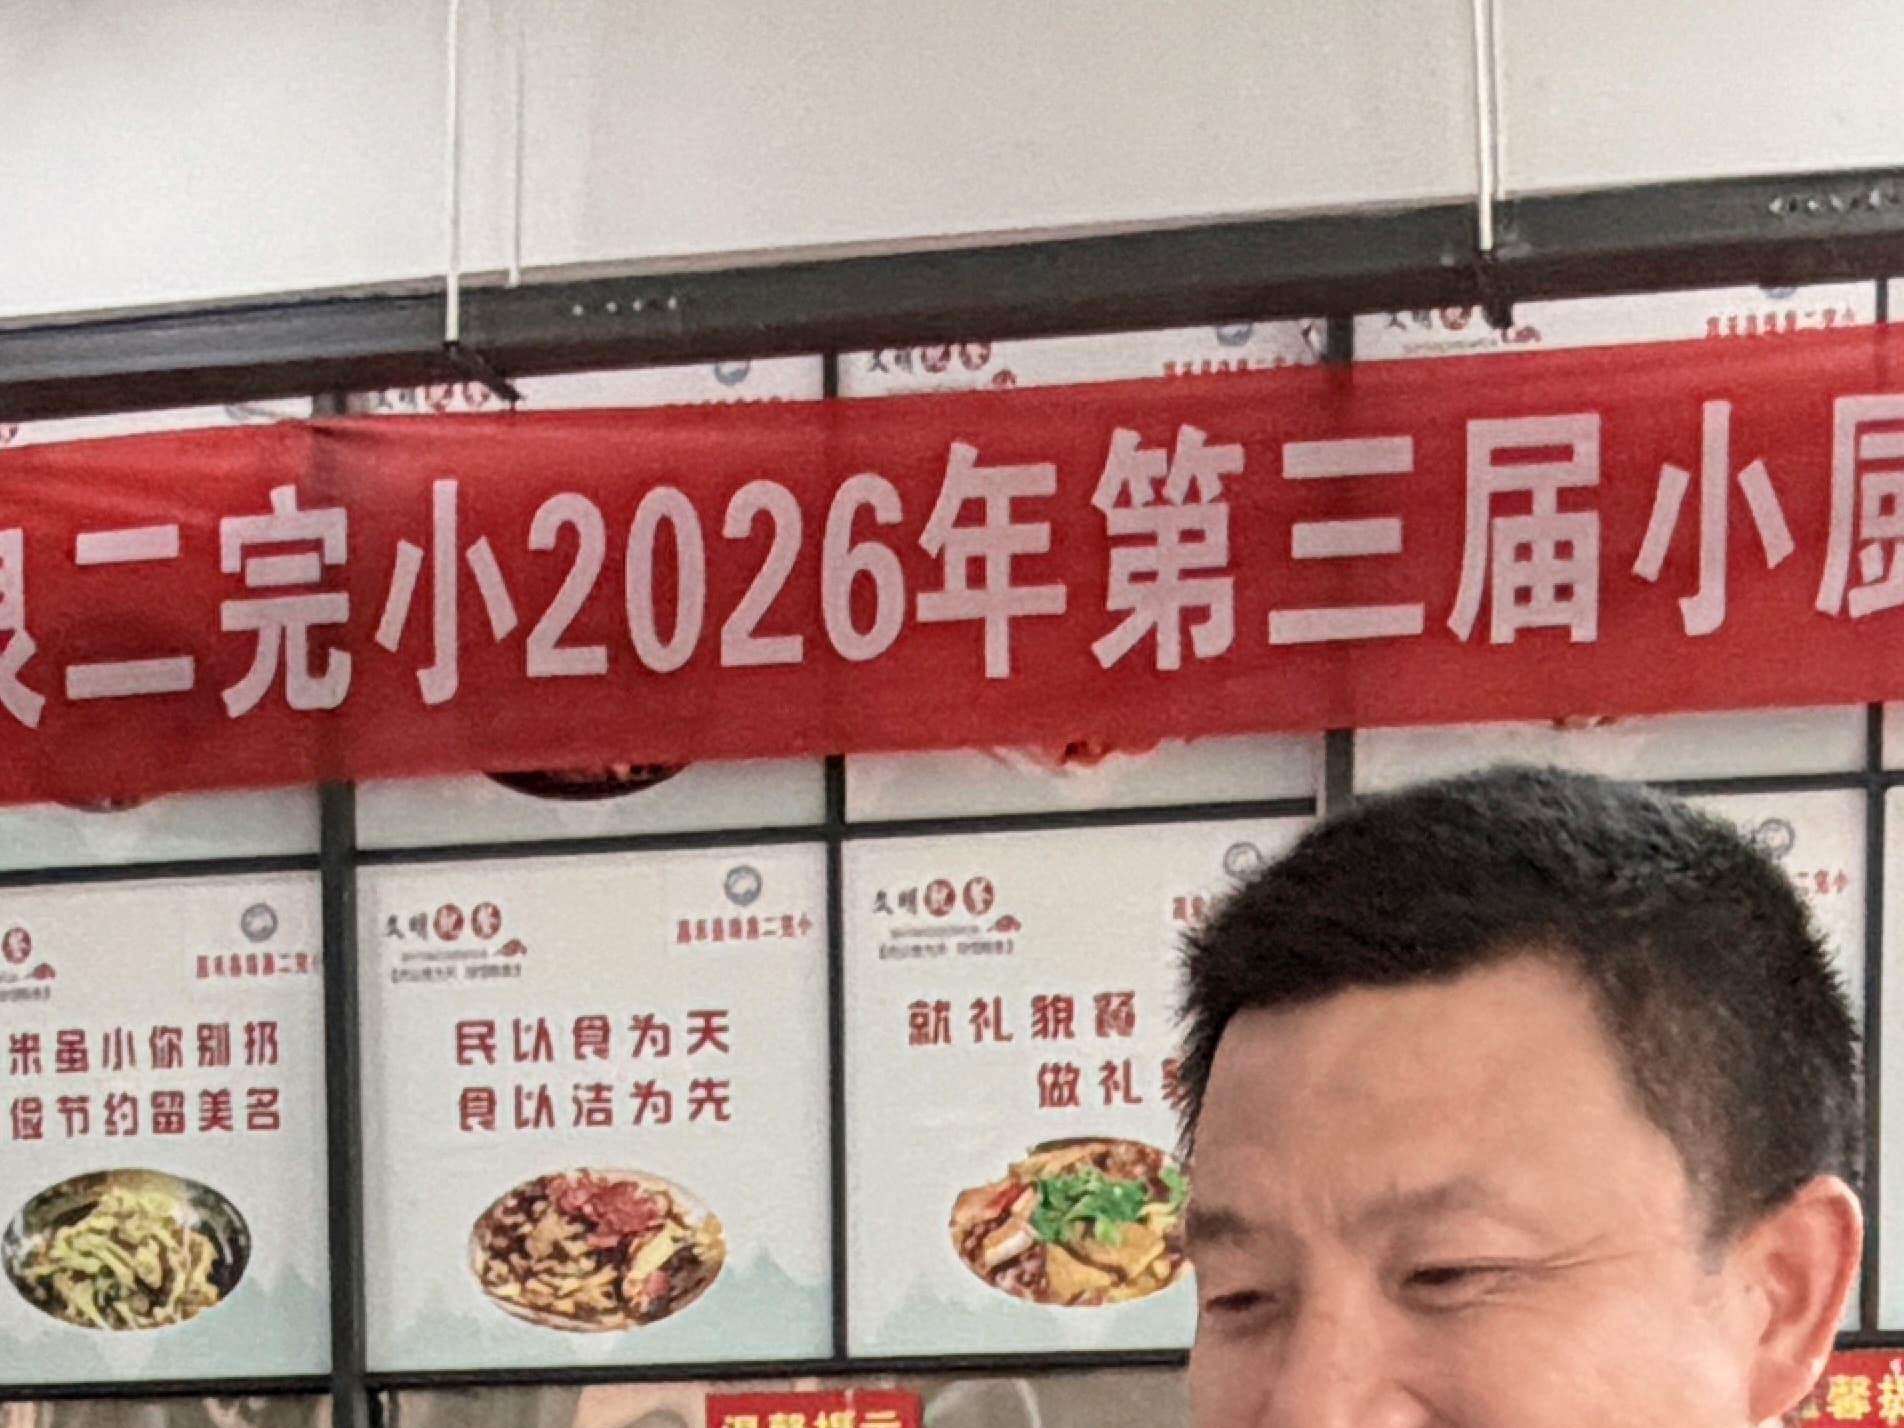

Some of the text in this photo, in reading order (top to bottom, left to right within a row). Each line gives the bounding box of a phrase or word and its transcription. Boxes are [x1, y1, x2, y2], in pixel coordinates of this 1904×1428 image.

[456, 1009, 730, 1065] 民以食为天
[459, 1078, 732, 1132] 食以洁为先
